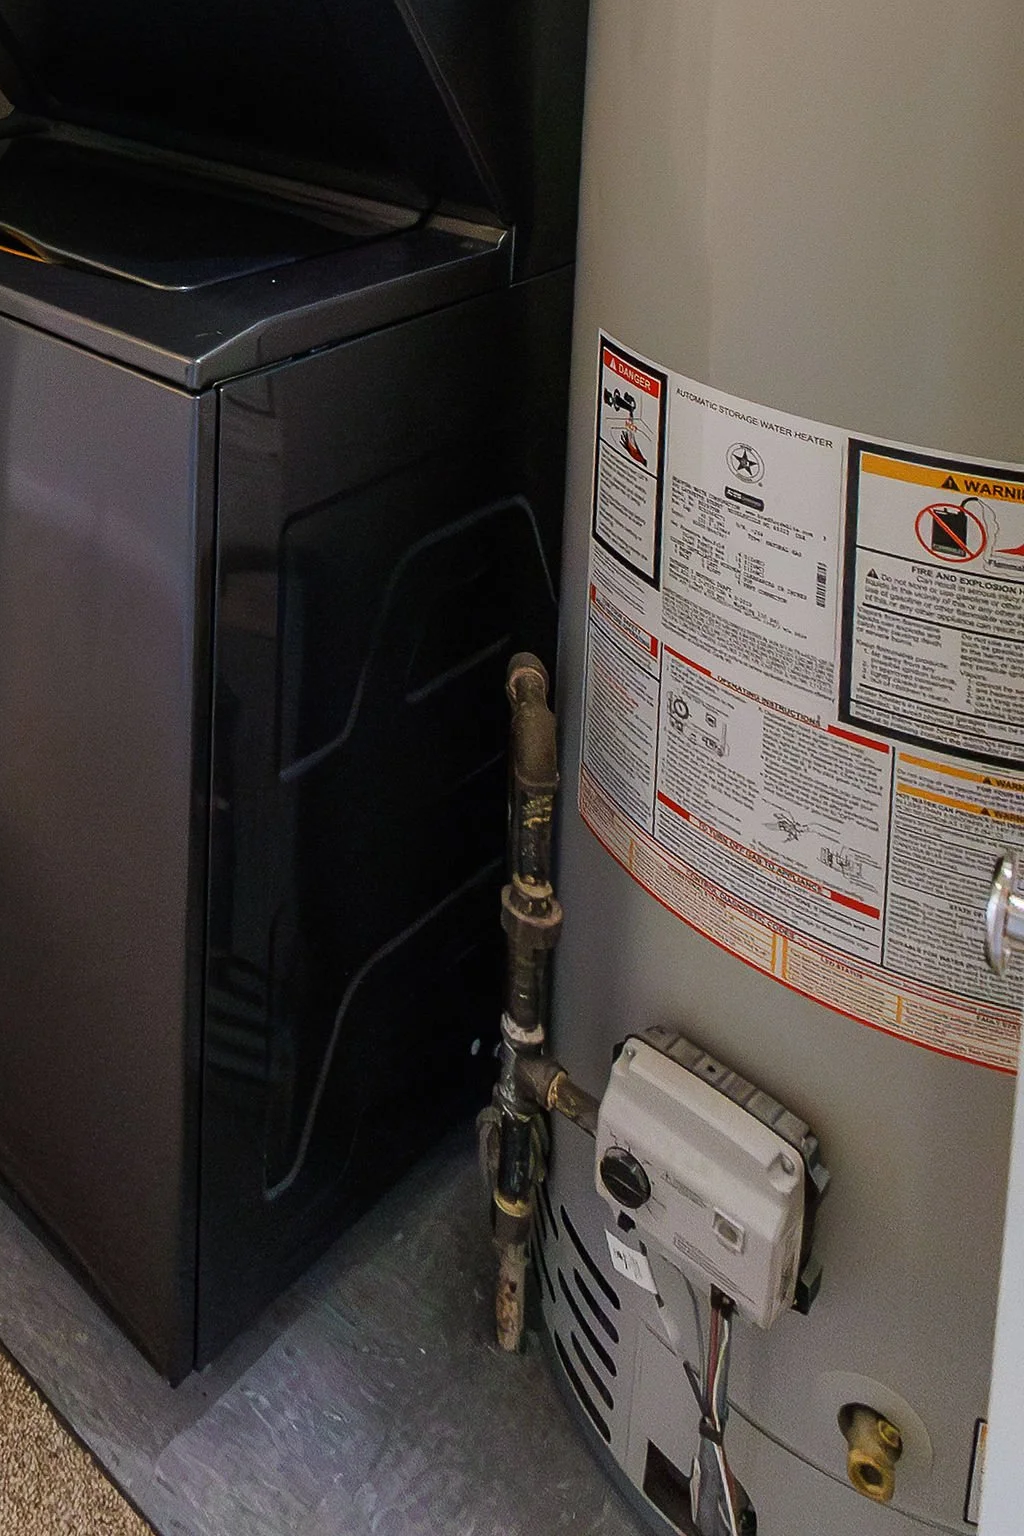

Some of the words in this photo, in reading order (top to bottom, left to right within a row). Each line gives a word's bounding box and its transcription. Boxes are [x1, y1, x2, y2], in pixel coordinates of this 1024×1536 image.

[618, 363, 651, 391] DANGER
[676, 387, 717, 411] AUTOMATIC
[719, 405, 759, 426] STORAGE
[760, 420, 793, 437] WATER
[794, 431, 833, 449] HEATER
[964, 479, 1024, 500] WARNI
[880, 573, 893, 583] Do
[911, 566, 934, 578] FIRE
[935, 571, 957, 583] AND
[959, 577, 1017, 594] EXPLOSION
